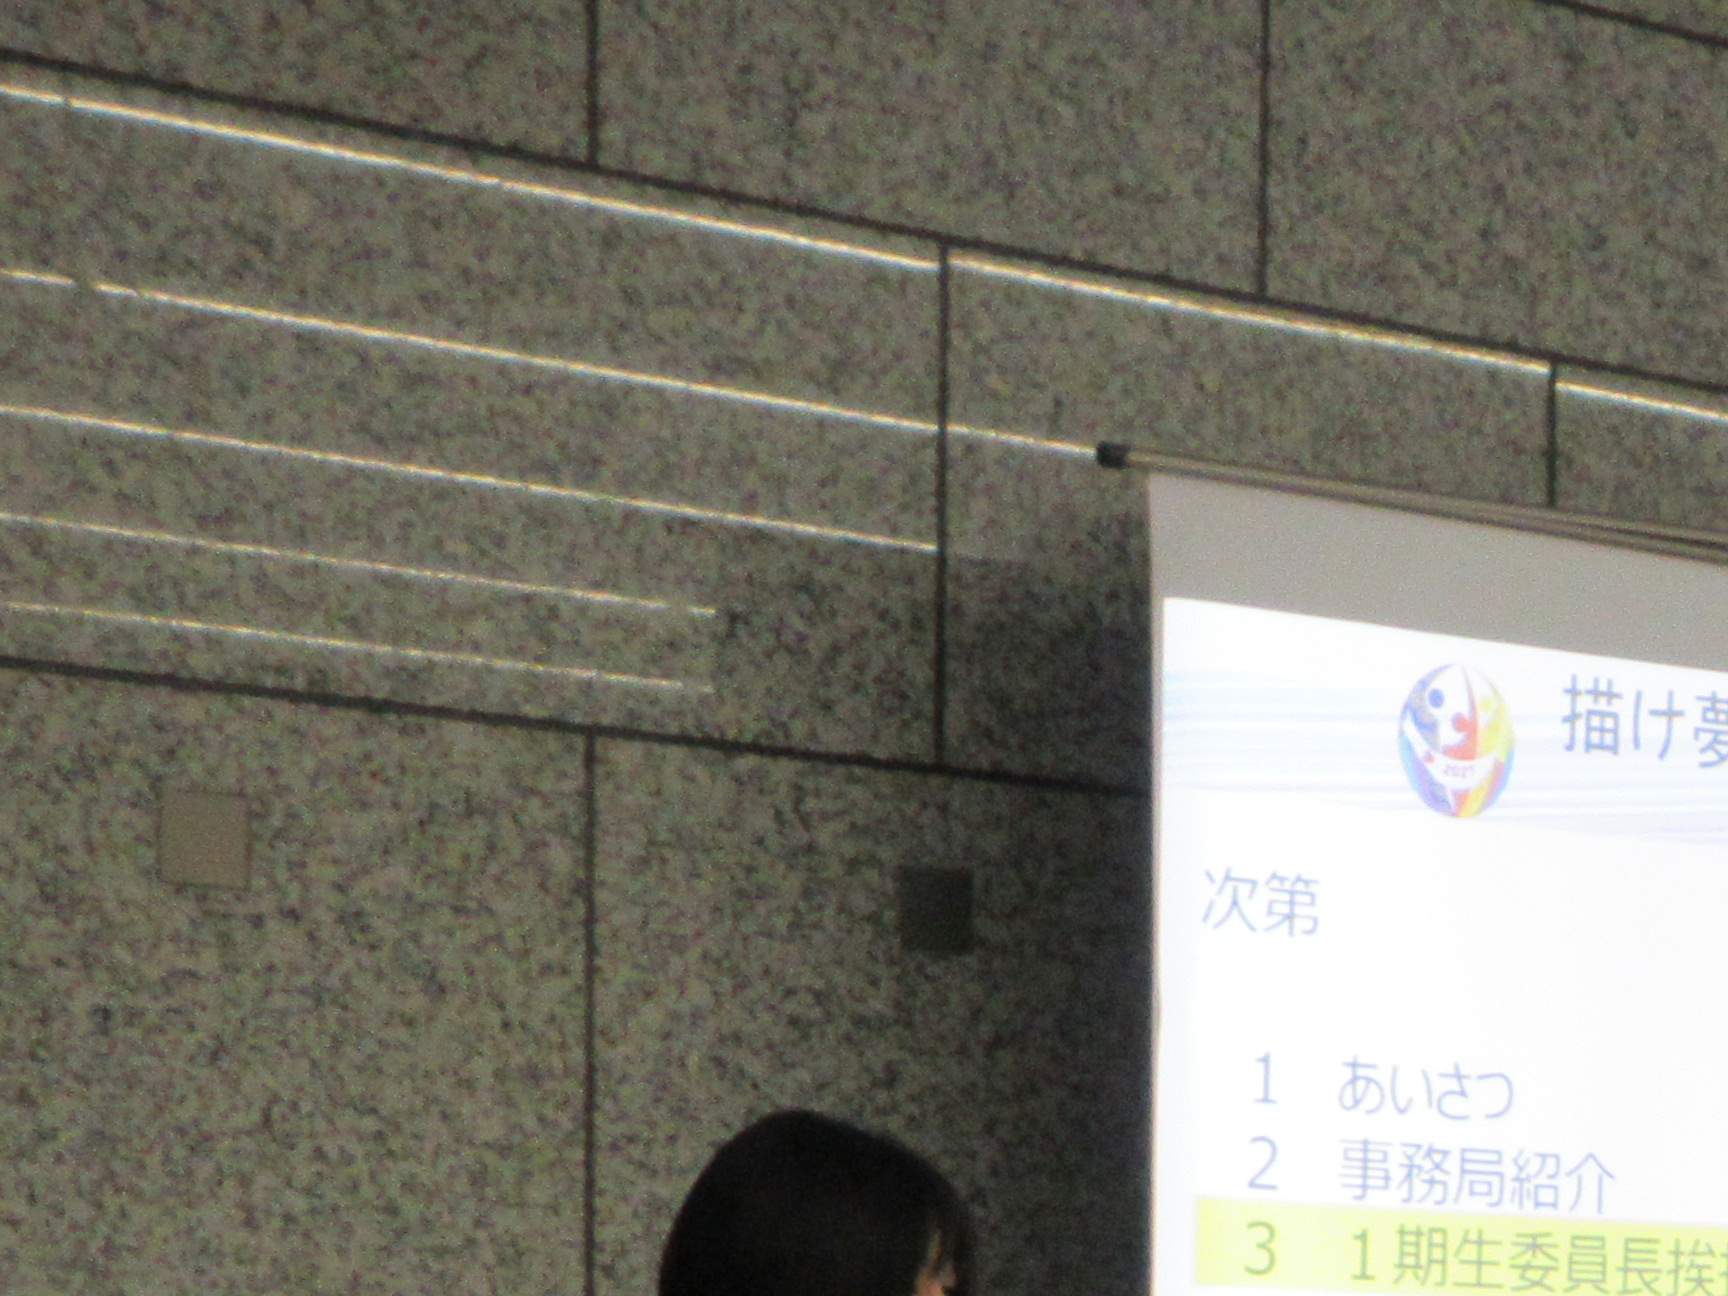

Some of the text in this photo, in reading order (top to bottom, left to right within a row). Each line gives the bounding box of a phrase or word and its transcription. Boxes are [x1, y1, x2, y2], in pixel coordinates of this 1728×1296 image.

[1201, 866, 1320, 938] 次第
[1254, 1052, 1279, 1105] 1
[1338, 1055, 1514, 1121] あいさつ
[1247, 1135, 1617, 1214] 2 事務局紹介
[1242, 1220, 1278, 1276] 3
